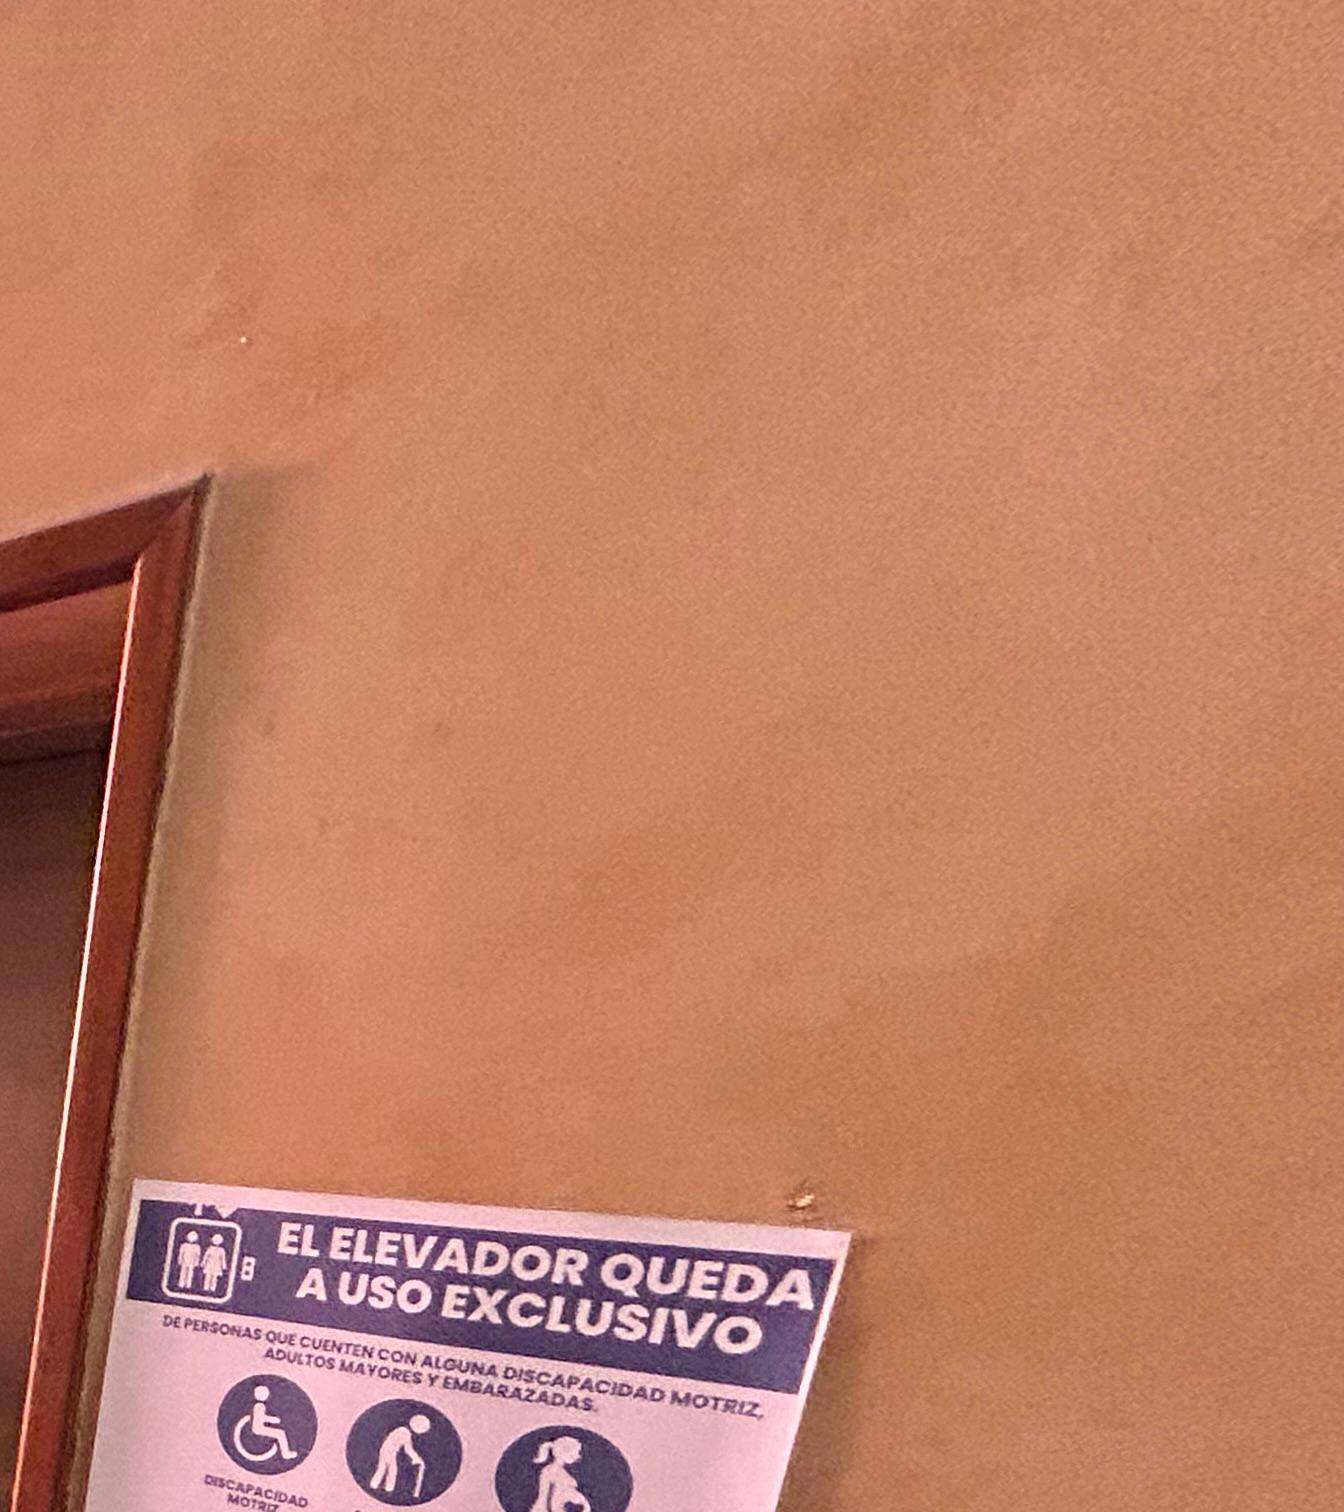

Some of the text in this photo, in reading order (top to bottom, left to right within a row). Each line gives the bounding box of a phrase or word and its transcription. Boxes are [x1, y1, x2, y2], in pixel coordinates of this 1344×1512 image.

[277, 1221, 814, 1311] EL ELEVADOR QUEDA
[295, 1267, 762, 1355] A USO EXCLUSIVO
[162, 1314, 764, 1420] DE PERSONAS QUE CUENTEN CON ALGUNA DISCAPACIDAD MOTRIZ,
[264, 1347, 335, 1371] ADULTOS
[338, 1358, 423, 1386] MAYORES
[427, 1372, 440, 1388] Y
[204, 1474, 309, 1508] DISCAPACIDAD
